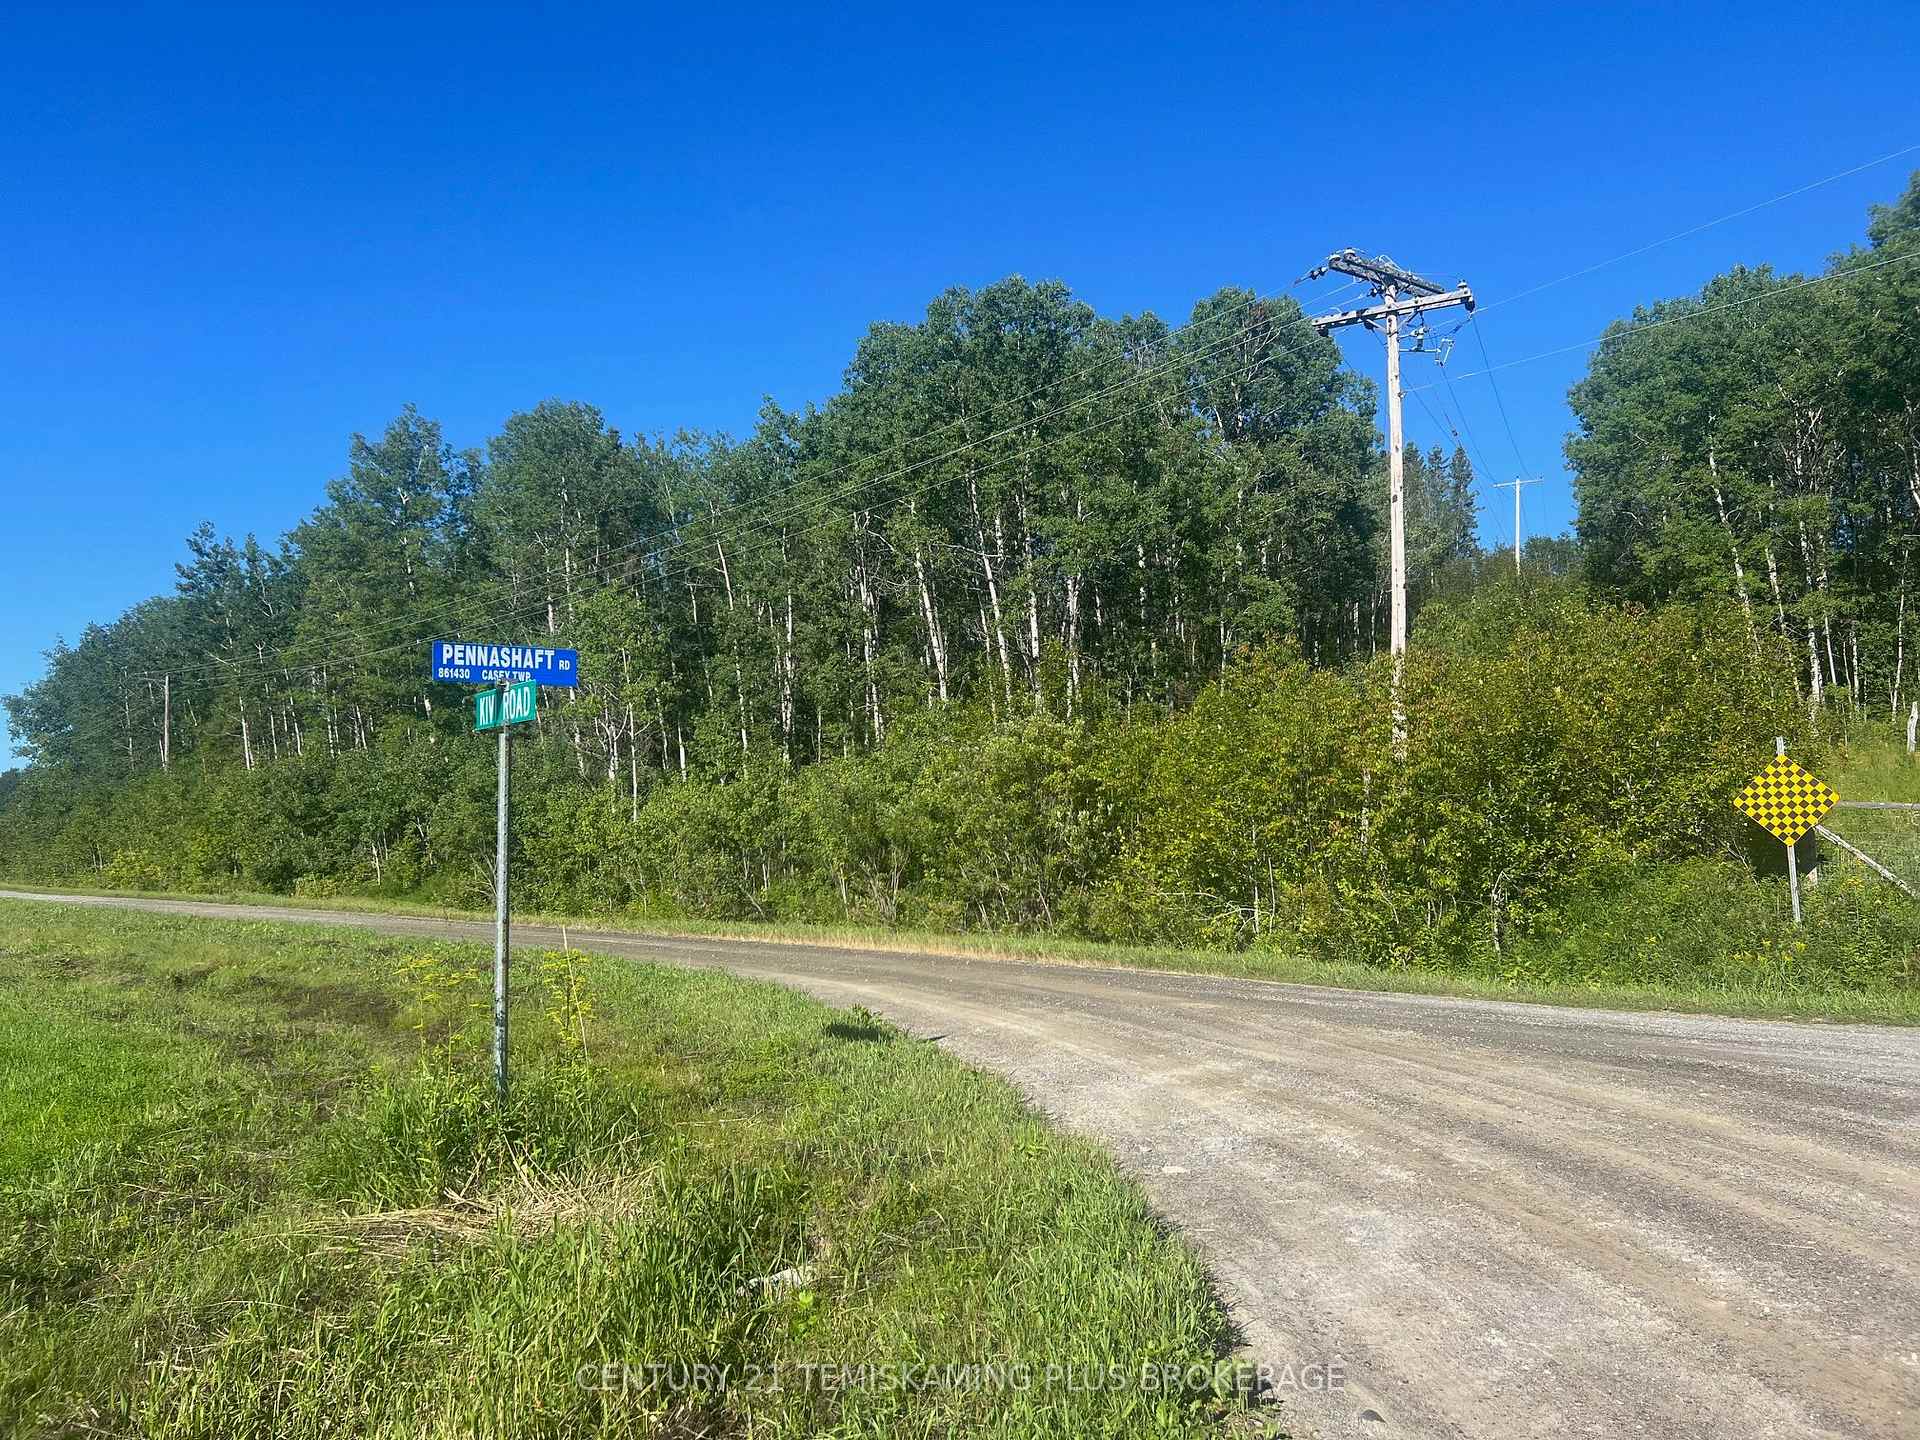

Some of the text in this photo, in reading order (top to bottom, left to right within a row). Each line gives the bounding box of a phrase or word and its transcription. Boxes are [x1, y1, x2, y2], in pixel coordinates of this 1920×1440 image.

[442, 644, 570, 670] PENNASHAFT RD
[438, 668, 470, 679] 861430
[481, 670, 510, 681] CASEY
[502, 687, 530, 720] ROAD
